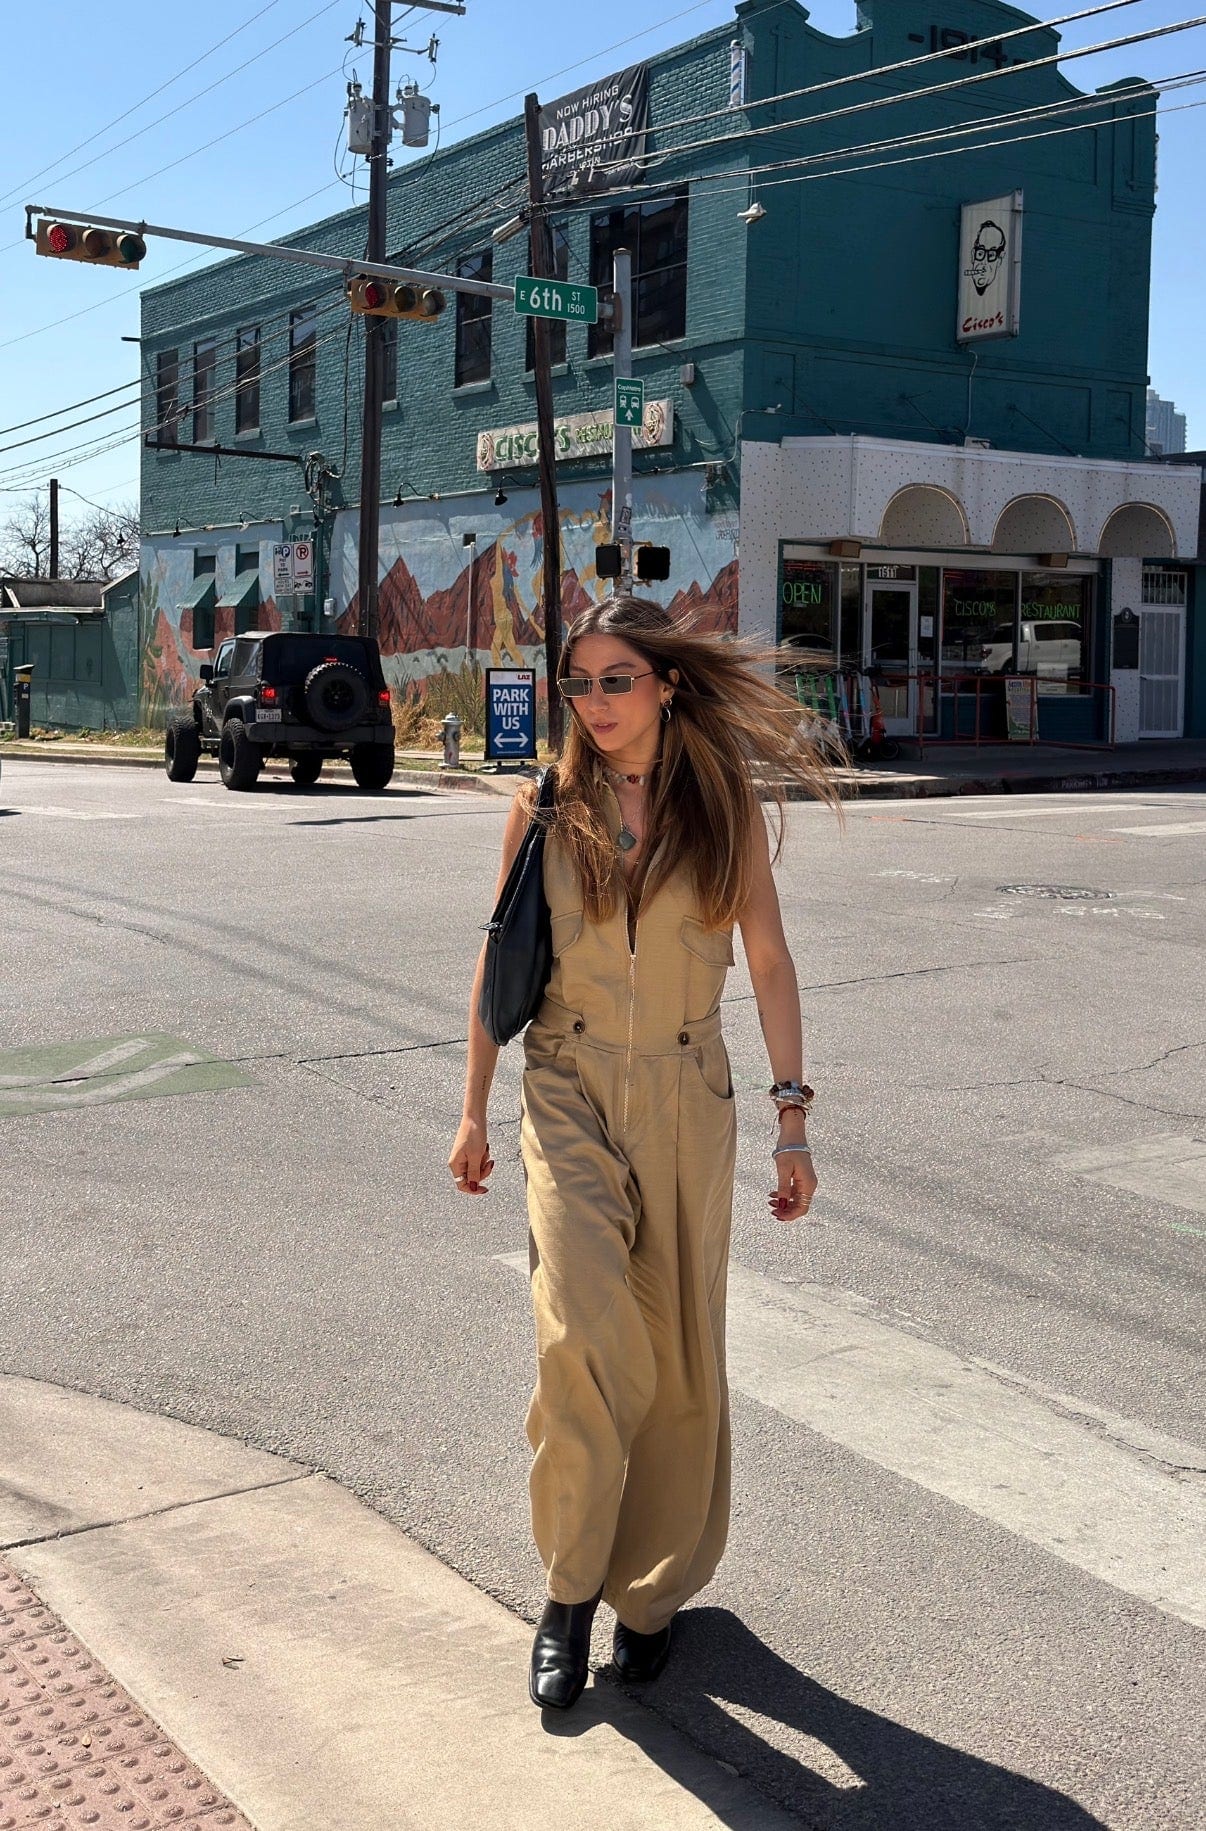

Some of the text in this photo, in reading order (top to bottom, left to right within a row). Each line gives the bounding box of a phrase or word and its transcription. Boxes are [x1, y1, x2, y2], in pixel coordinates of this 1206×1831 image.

[556, 85, 619, 120] NOW HIRING
[542, 94, 633, 151] DADDY'S
[520, 286, 581, 311] E 6th ST
[567, 303, 585, 314] 1500
[962, 311, 1004, 333] Cisco's
[495, 425, 571, 462] CISC'S
[782, 581, 821, 604] OPEN
[1021, 601, 1080, 619] RESTAURANT
[493, 688, 530, 702] PARK
[493, 702, 529, 716] WITH
[502, 716, 521, 730] US
